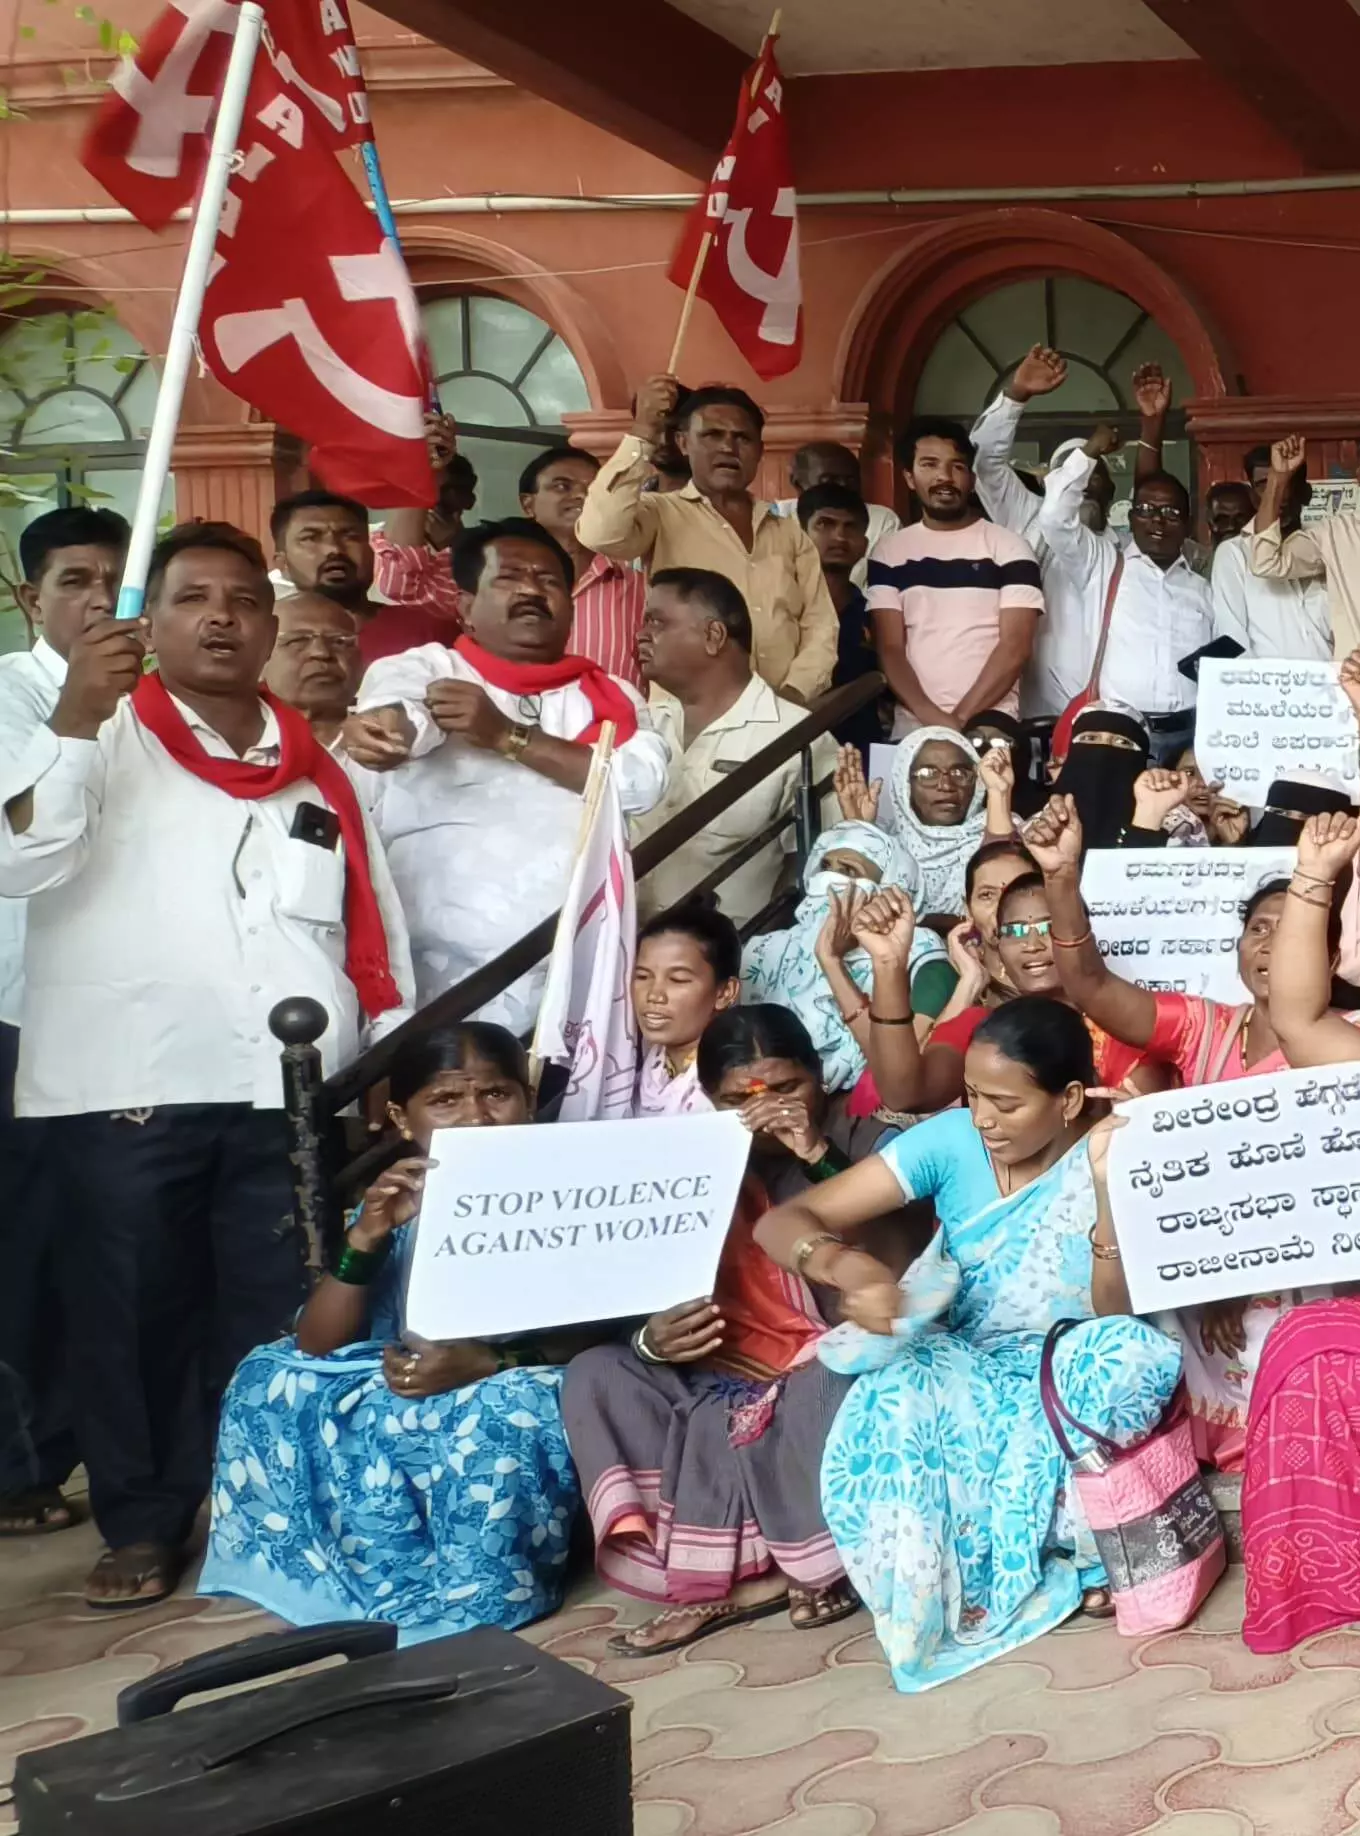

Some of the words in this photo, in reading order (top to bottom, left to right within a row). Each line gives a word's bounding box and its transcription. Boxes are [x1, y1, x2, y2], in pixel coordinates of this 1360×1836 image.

[1151, 1086, 1281, 1133] ವೀರೇಂದ್ರ
[1129, 1150, 1211, 1198] ನೈತಿಕ
[1227, 1132, 1306, 1170] ಹೊಣೆ
[453, 1190, 545, 1219] STOP
[551, 1174, 712, 1212] VIOLENCE
[1156, 1190, 1297, 1237] ರಾಜ್ಯಸಭಾ
[434, 1223, 587, 1259] AGAINST
[595, 1209, 714, 1243] WOMEN
[1156, 1234, 1315, 1282] ರಾಜೀನಾಮೆ
